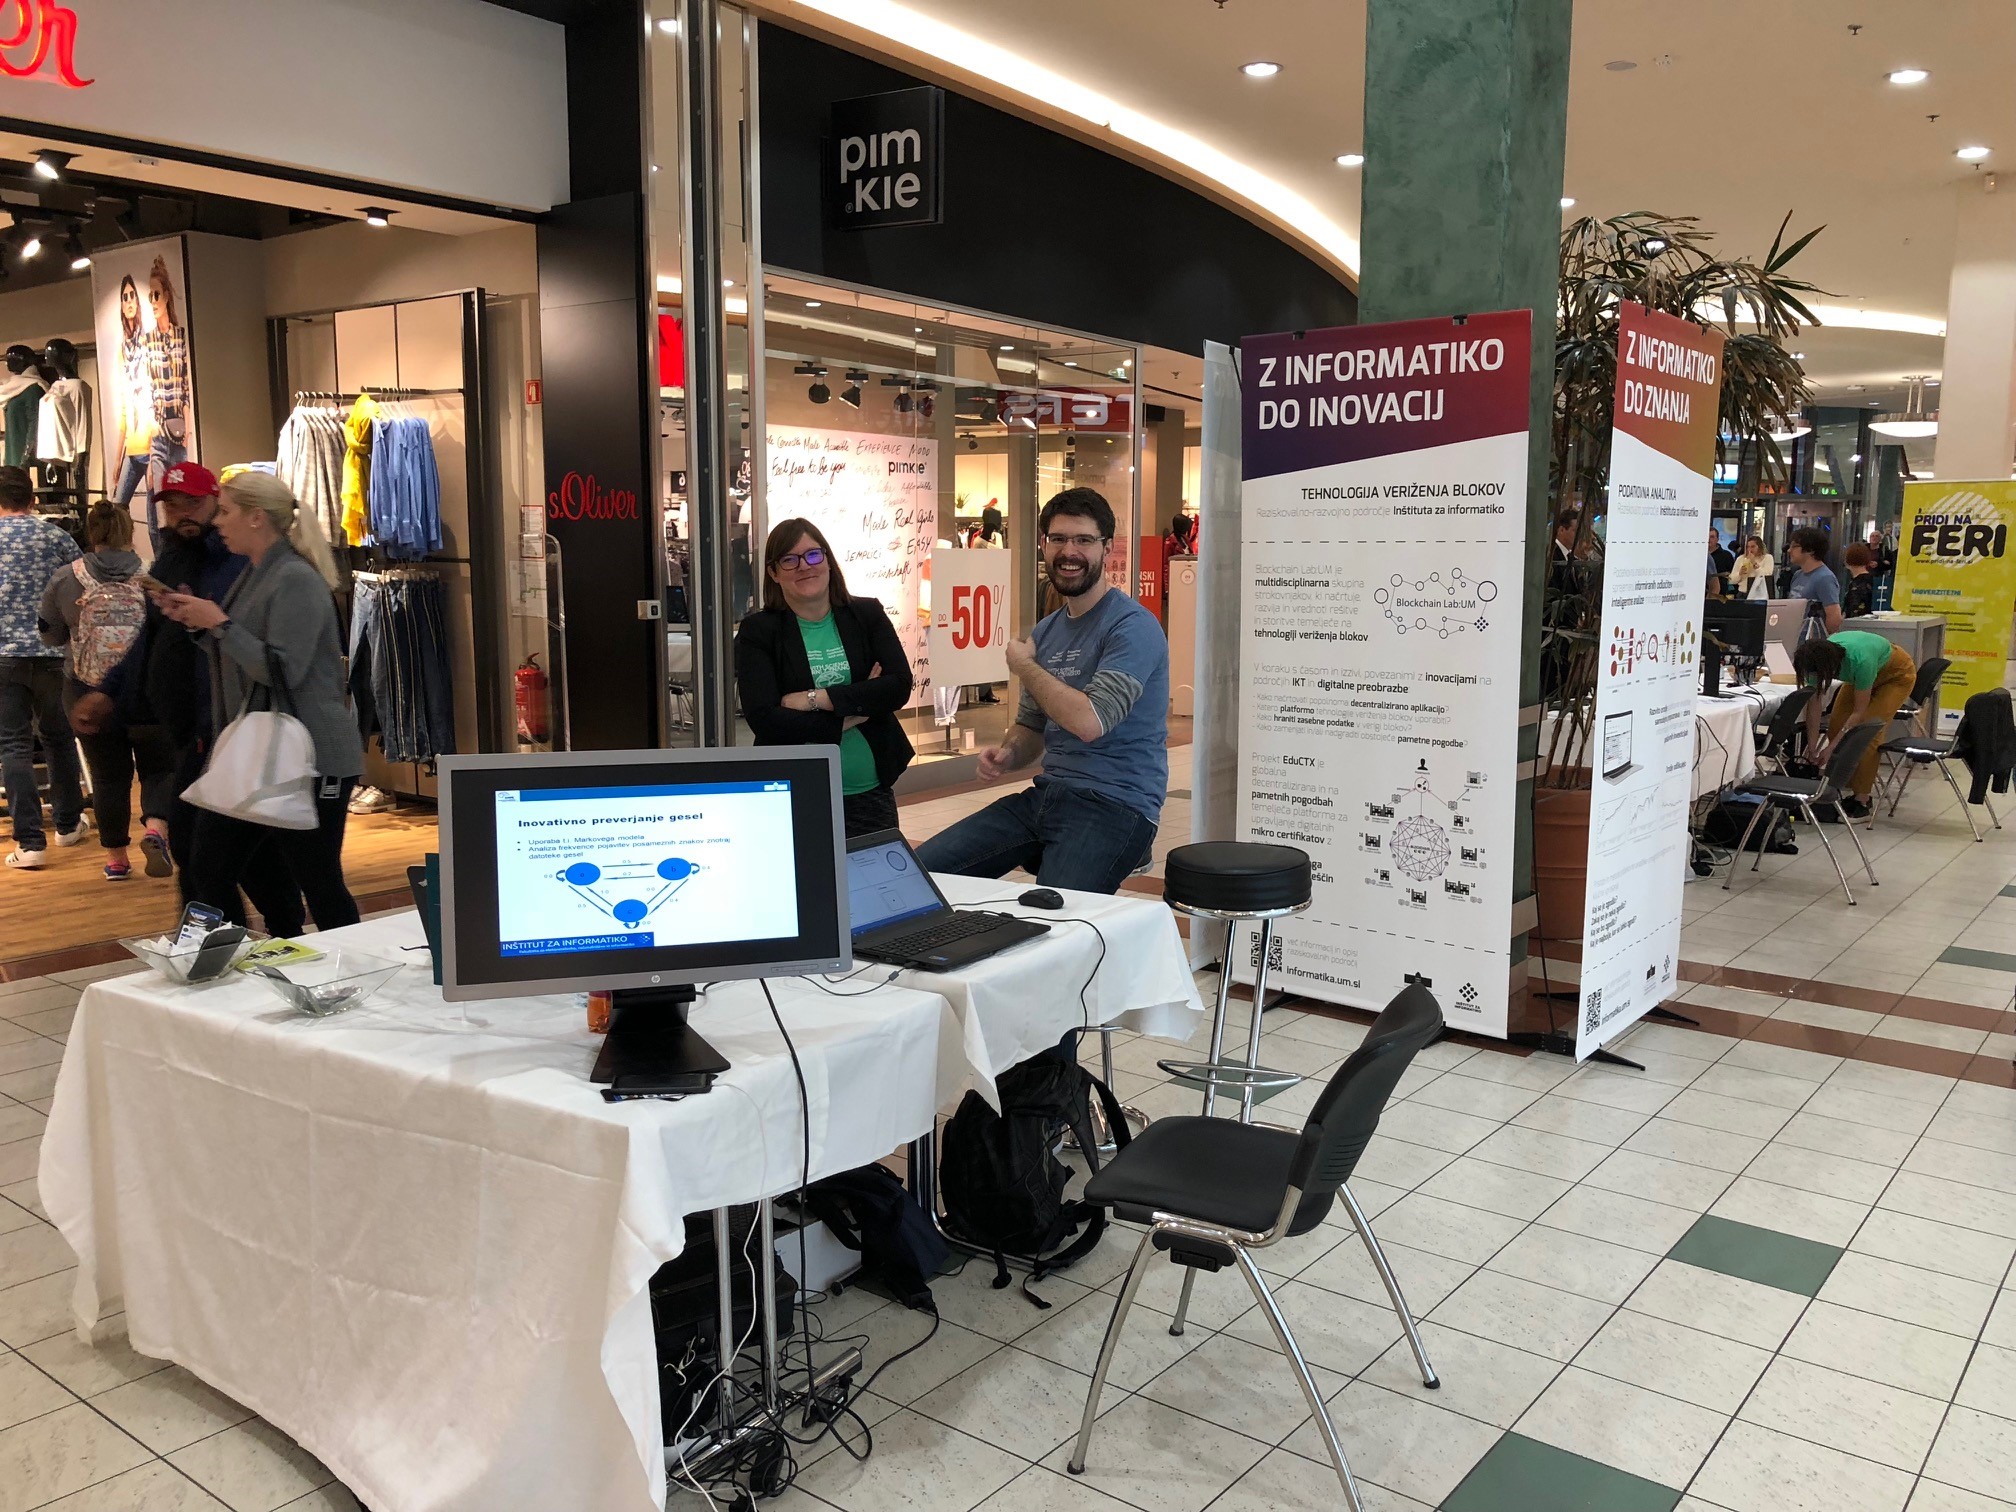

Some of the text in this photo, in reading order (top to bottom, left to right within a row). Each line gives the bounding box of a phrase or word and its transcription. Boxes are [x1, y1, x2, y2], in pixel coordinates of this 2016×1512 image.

[1258, 338, 1504, 387] Z INFORMATIKO
[1626, 330, 1715, 385] Z INFORMATIKO
[1258, 389, 1444, 430] DO INOVACIJ
[1624, 379, 1690, 425] DO ZNANJA
[888, 461, 925, 476] pimkie
[549, 471, 640, 520] s.Oliver
[1301, 482, 1506, 500] TEHNOLOGIJA VERIŽENJA BLOKOV
[1256, 504, 1505, 519] Raziskovalno-razvojno področje Inštituta za informatiko
[1914, 514, 1972, 526] PRIDI NA
[1910, 524, 2007, 558] FERI
[1255, 564, 1299, 574] Blockchain
[1334, 566, 1343, 577] je
[1255, 577, 1365, 589] multidisciplinarna skupina
[1315, 591, 1323, 600] ki
[1254, 604, 1358, 615] razvija in vrednoti rešitve
[1396, 598, 1476, 609] Blockchain Lab:UM
[939, 613, 947, 622] DO
[1254, 616, 1352, 629] in storitve temelječe na
[1254, 629, 1369, 642] tehnologiji veriženja blokov
[1253, 662, 1259, 671] V
[1262, 662, 1291, 674] koraku
[1292, 666, 1298, 674] s
[1300, 665, 1329, 676] časom
[1330, 667, 1339, 676] in
[1364, 670, 1416, 680] povezanimi
[1417, 673, 1423, 681] z
[1425, 672, 1477, 686] inovacijami
[1479, 676, 1492, 686] na
[1253, 676, 1409, 694] področjih IKT in digitalne preobrazbe
[1280, 704, 1315, 714] platformo
[1350, 699, 1409, 711] decentralizirano
[1273, 714, 1296, 723] hraniti
[1297, 716, 1325, 726] zasebne
[1326, 718, 1355, 728] podatke
[1397, 734, 1430, 745] pametne
[1252, 752, 1325, 770] Projekt EduCTX je
[1252, 765, 1287, 777] globalna
[1252, 778, 1339, 795] decentralizirana in na
[1251, 791, 1333, 807] pametnih pogodbah
[1251, 802, 1348, 822] temelječa platforma za
[518, 812, 703, 828] Inovativno preverjanje gesel
[1251, 815, 1335, 832] upravljanje digitalnih
[528, 838, 561, 846] Uporaba
[574, 836, 615, 844] Markovega
[1251, 826, 1275, 838] mikro
[1276, 830, 1326, 844] certifikatov
[558, 844, 595, 852] frekvence
[597, 841, 630, 851] pojavitev
[632, 839, 676, 848] posameznih
[707, 837, 731, 845] znotraj
[528, 852, 584, 860] datoteke gesel
[503, 935, 628, 950] INŠTITUT ZA INFORMATIKO
[1287, 938, 1299, 946] več
[1300, 940, 1334, 952] informacij
[1335, 946, 1341, 954] in
[1286, 965, 1361, 989] informatika.um.si
